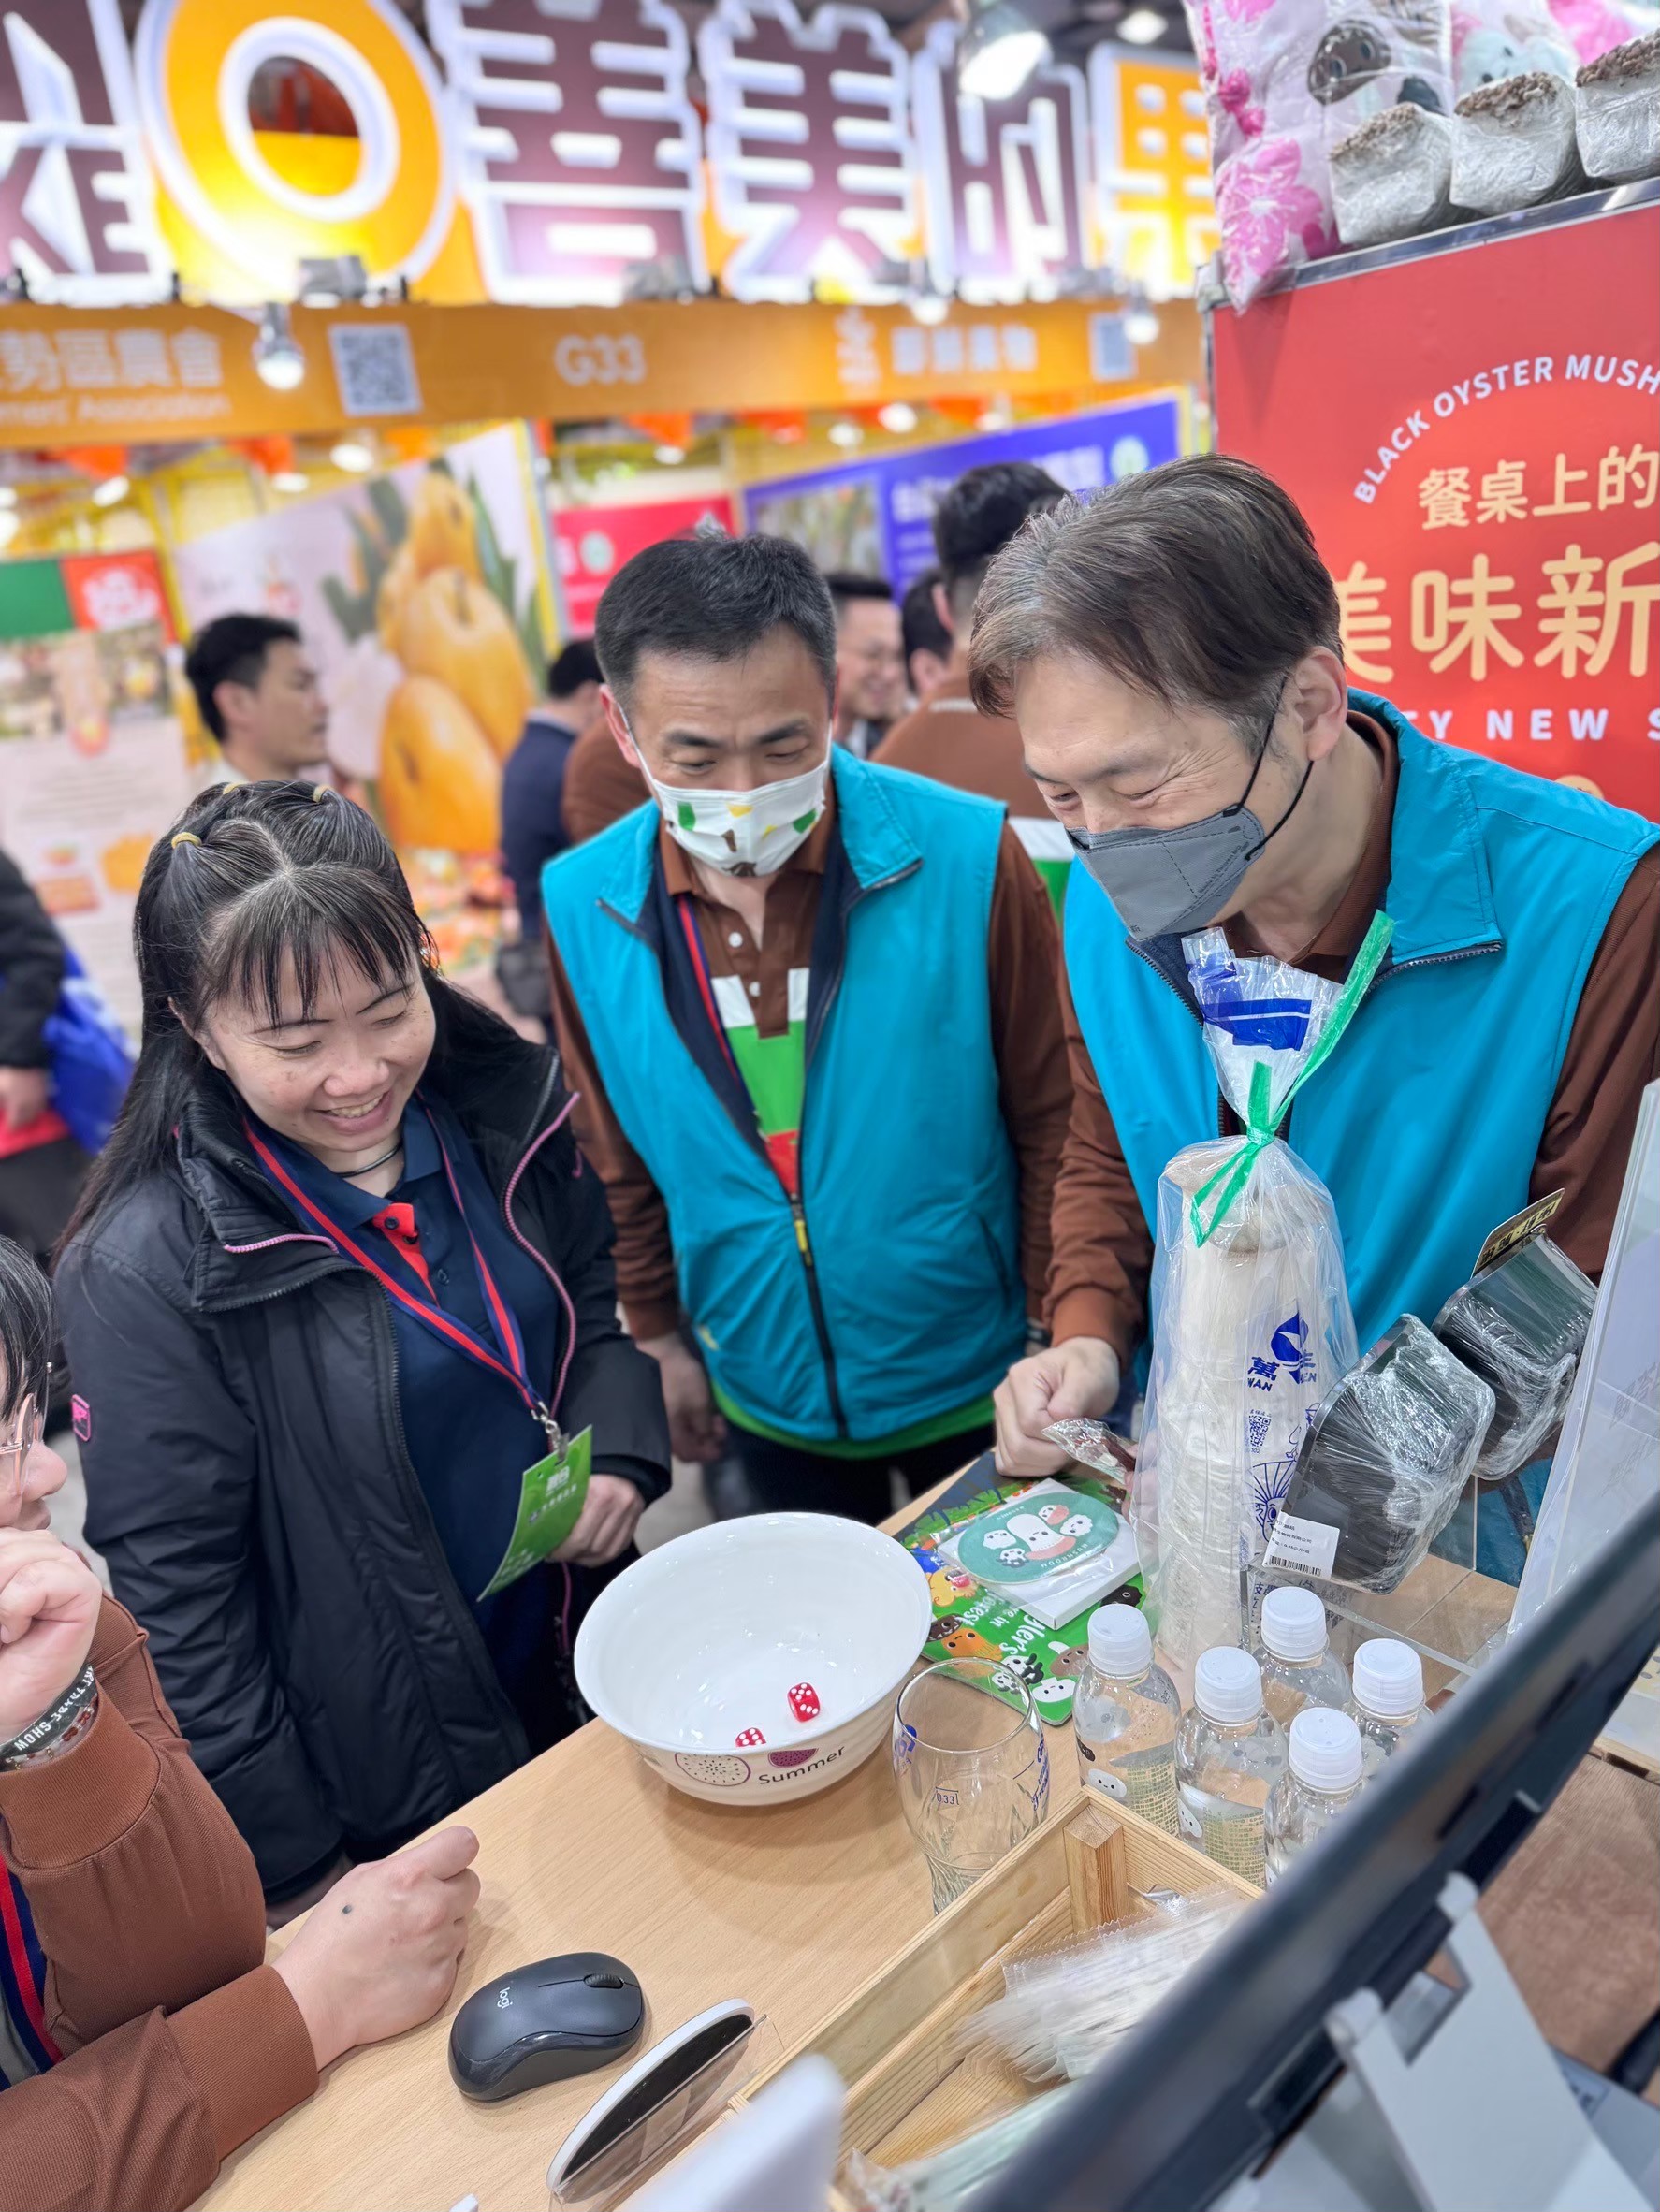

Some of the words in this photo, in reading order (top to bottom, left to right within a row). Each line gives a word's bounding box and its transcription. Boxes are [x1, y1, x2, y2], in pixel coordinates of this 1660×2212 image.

[554, 335, 645, 385] G33
[1353, 409, 1431, 504] BLACK
[1433, 357, 1554, 418] OYSTER
[1418, 443, 1660, 531] 餐桌上的
[1486, 708, 1609, 740] NEW
[13, 1722, 52, 1752] SHOW
[759, 1746, 846, 1785] Summer
[497, 1986, 514, 2010] logi
